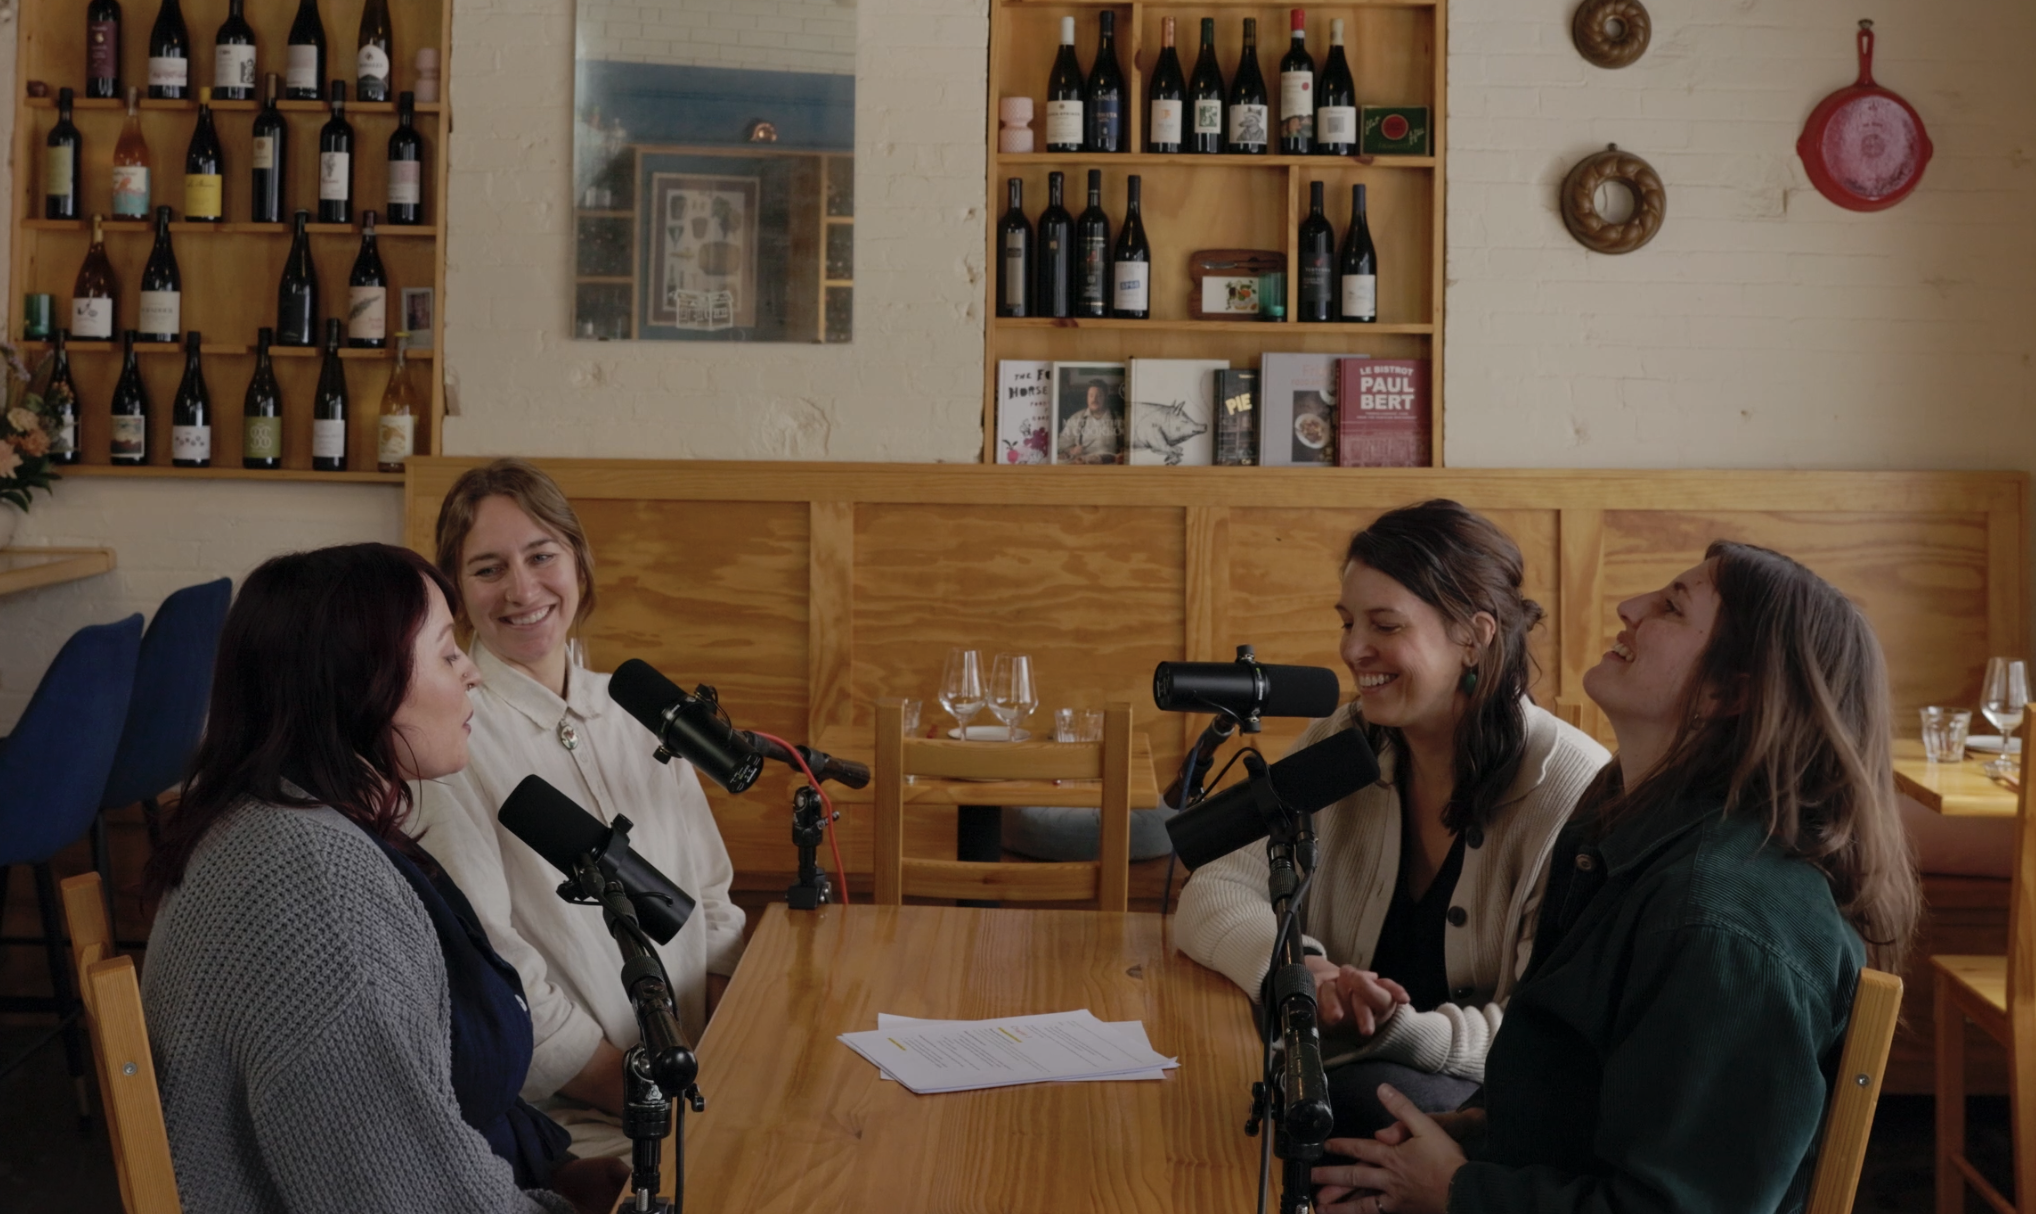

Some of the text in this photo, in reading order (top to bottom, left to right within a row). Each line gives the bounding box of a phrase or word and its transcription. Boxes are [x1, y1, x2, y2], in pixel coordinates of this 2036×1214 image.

[1014, 372, 1033, 381] THE
[1359, 365, 1415, 377] LE BISTROT
[1360, 376, 1416, 393] PAUL
[1225, 391, 1253, 416] PIE
[1360, 394, 1416, 410] BERT
